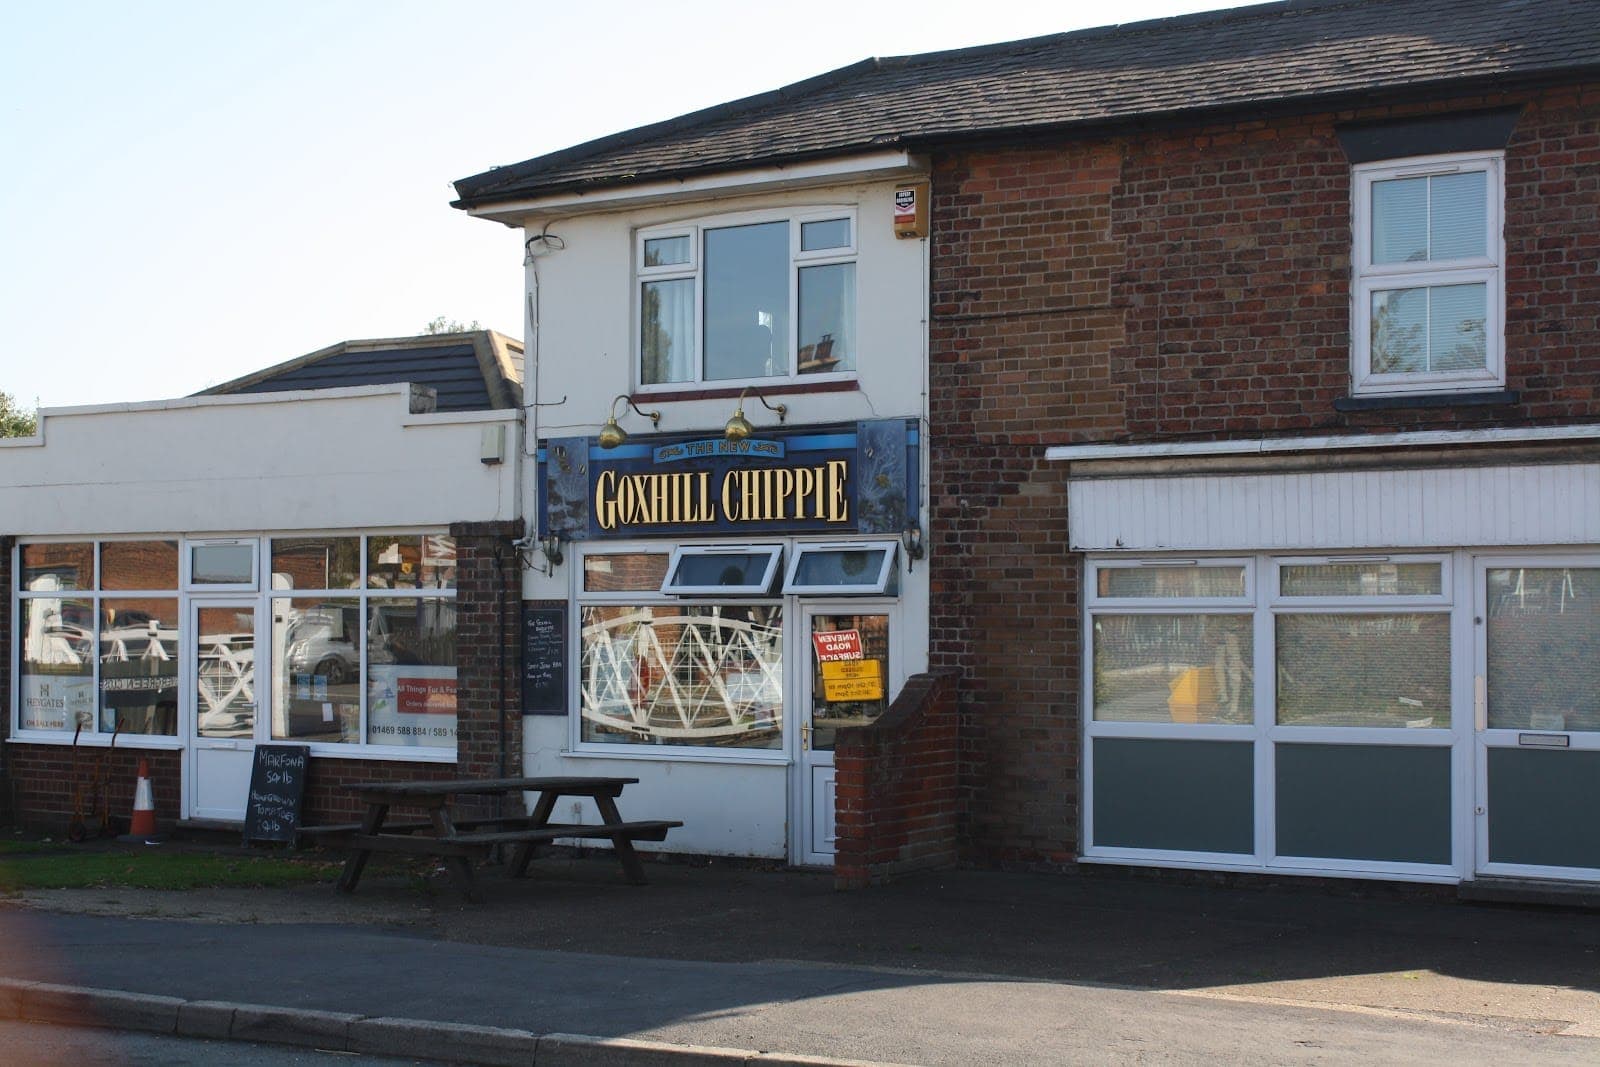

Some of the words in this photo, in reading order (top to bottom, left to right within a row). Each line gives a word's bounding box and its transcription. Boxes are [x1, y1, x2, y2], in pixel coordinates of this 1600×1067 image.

[686, 442, 713, 455] THE
[719, 440, 751, 454] NEW
[595, 470, 716, 530] GOXHILL
[721, 460, 848, 524] CHIPPIE
[406, 685, 427, 694] Things
[372, 725, 395, 735] 01469
[397, 726, 411, 735] 588
[259, 750, 304, 769] MARFONA
